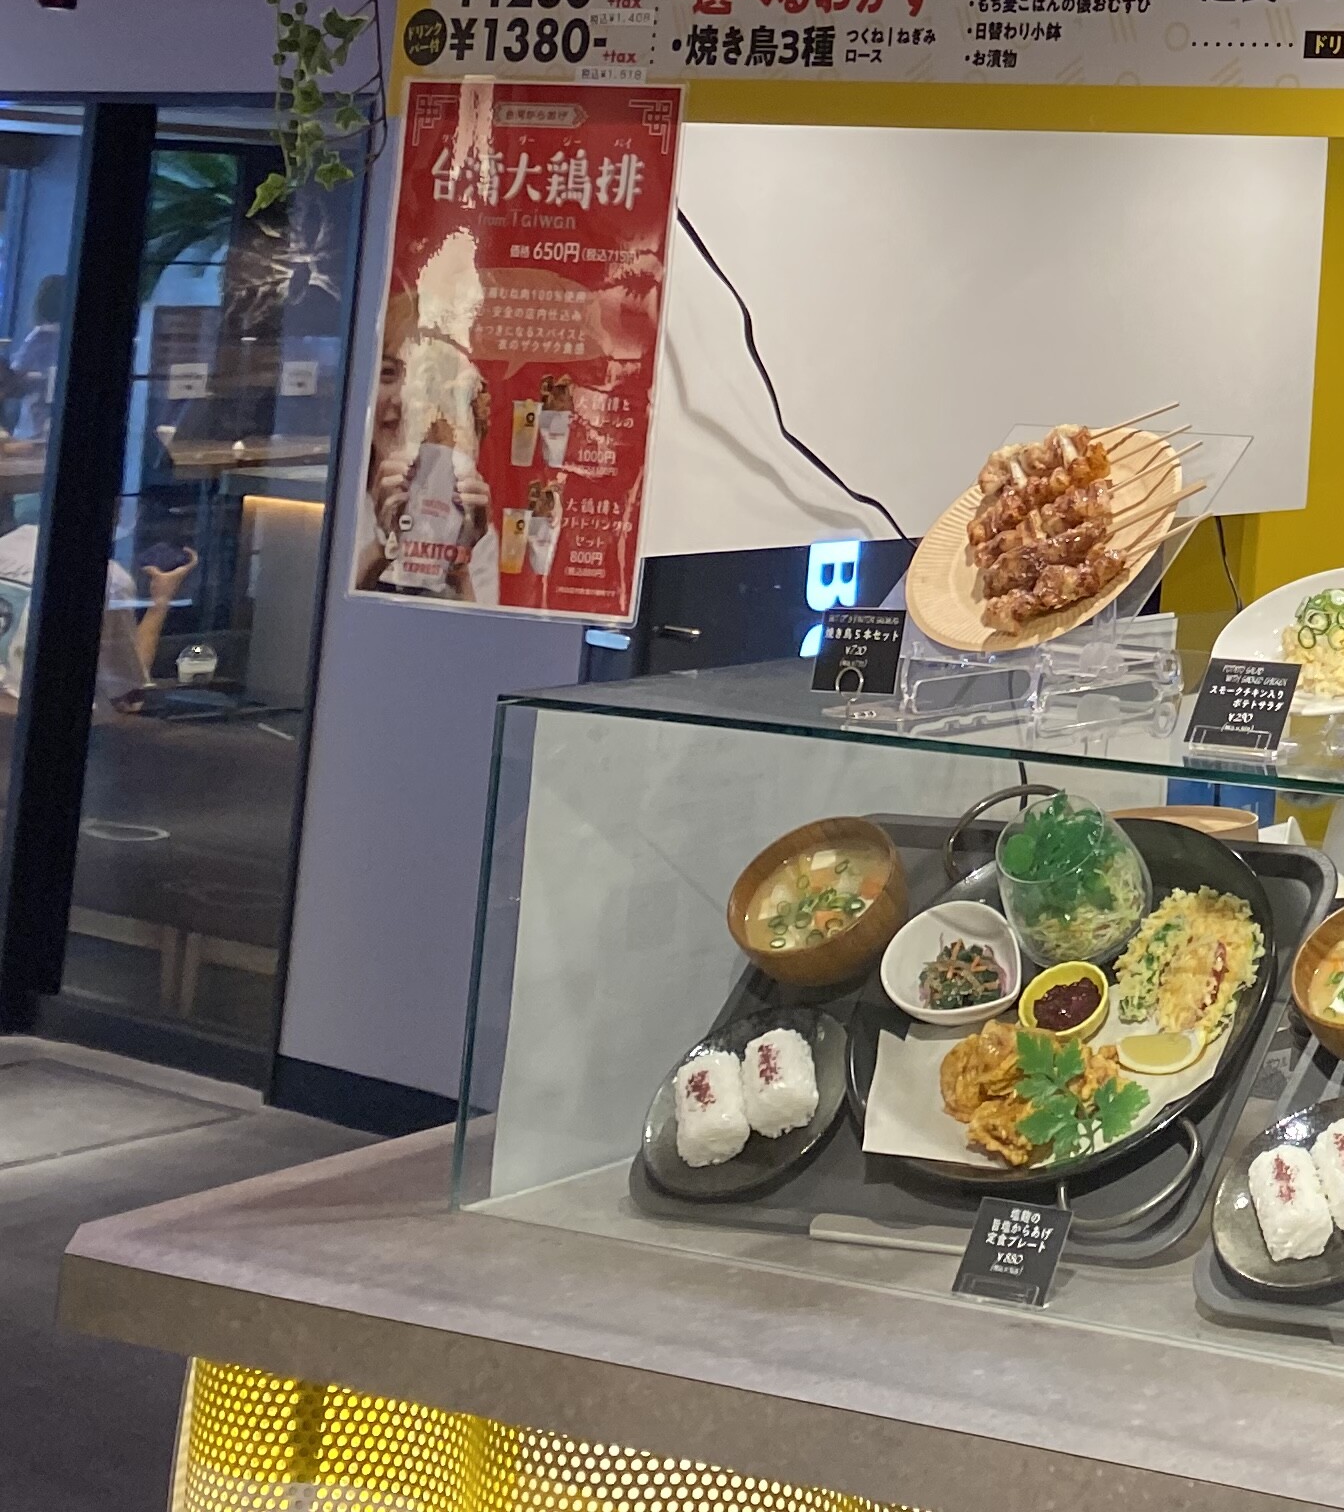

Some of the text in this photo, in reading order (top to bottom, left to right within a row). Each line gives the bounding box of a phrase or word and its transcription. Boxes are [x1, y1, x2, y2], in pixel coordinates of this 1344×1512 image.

[684, 24, 836, 67] 焼き鳥3種
[603, 51, 636, 64] +tax
[845, 50, 882, 64] ロース
[511, 209, 576, 230] Taiwan
[532, 243, 580, 262] 650円
